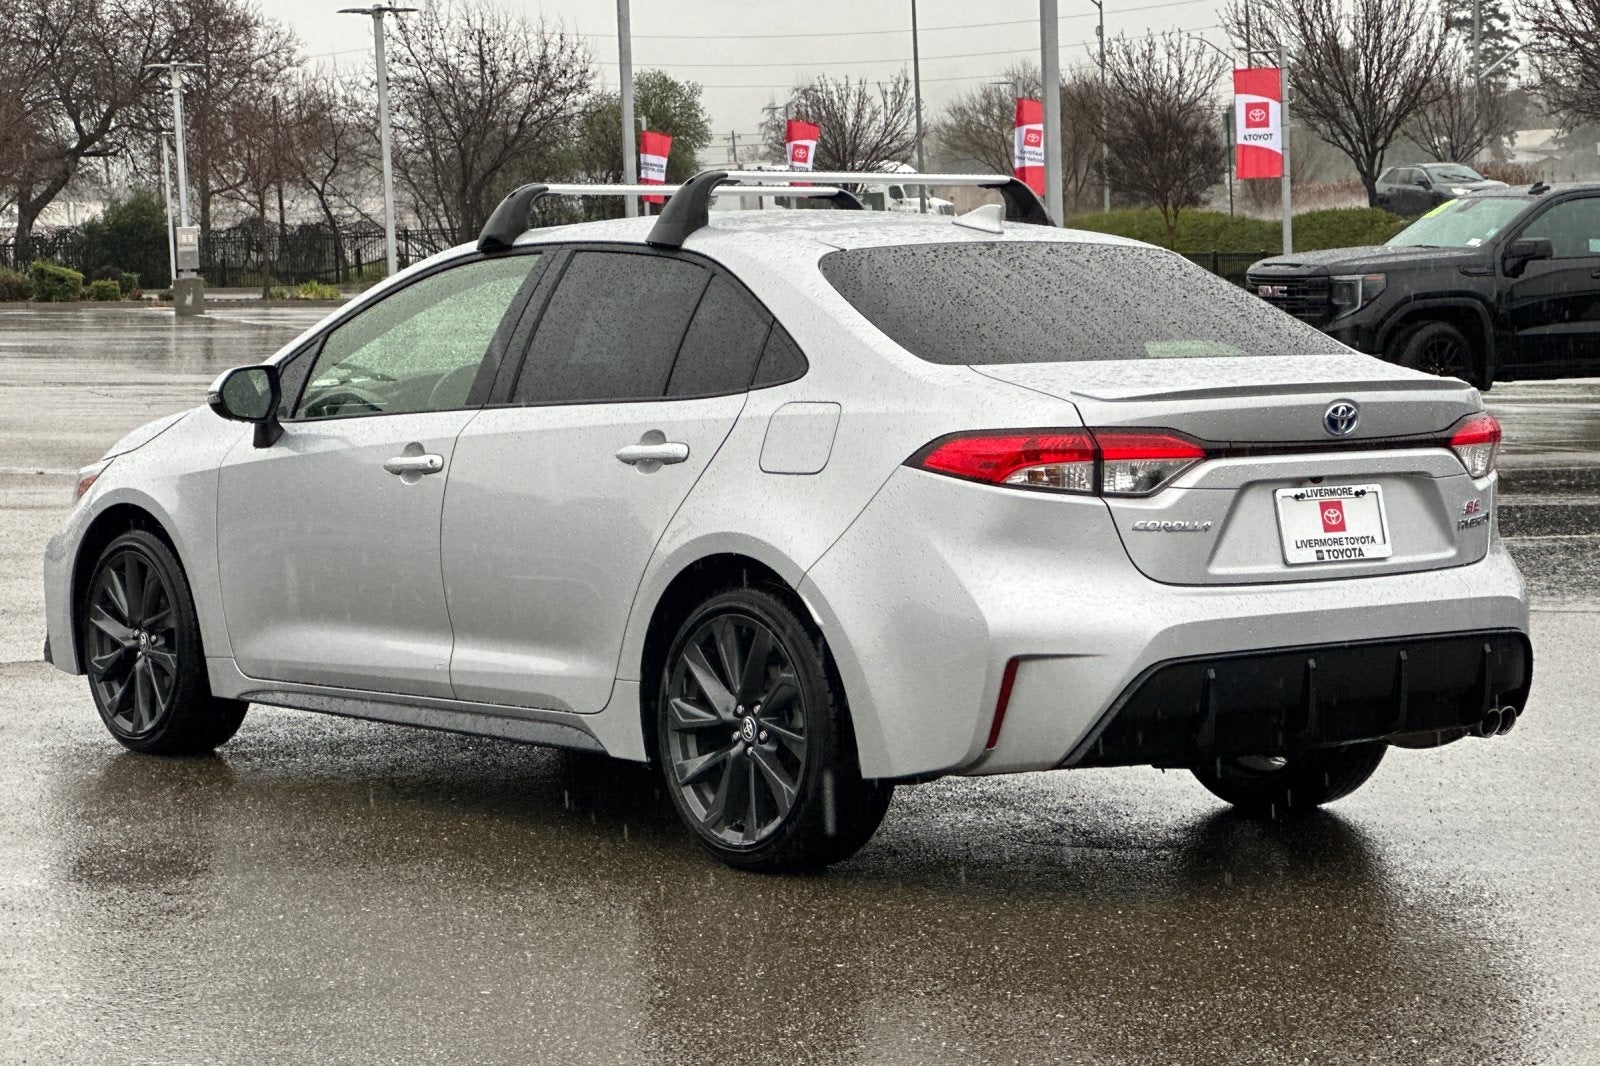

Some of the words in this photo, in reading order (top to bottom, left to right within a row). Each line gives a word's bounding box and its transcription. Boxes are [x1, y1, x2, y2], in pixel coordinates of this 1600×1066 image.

[1258, 285, 1288, 298] GMC
[1305, 487, 1354, 498] LIVERMORE
[1462, 499, 1480, 515] SE
[1132, 520, 1212, 532] COROLLA
[1295, 537, 1344, 549] LIVERMORE
[1344, 535, 1377, 547] TOYOTA
[1325, 547, 1365, 559] TOYOTA
